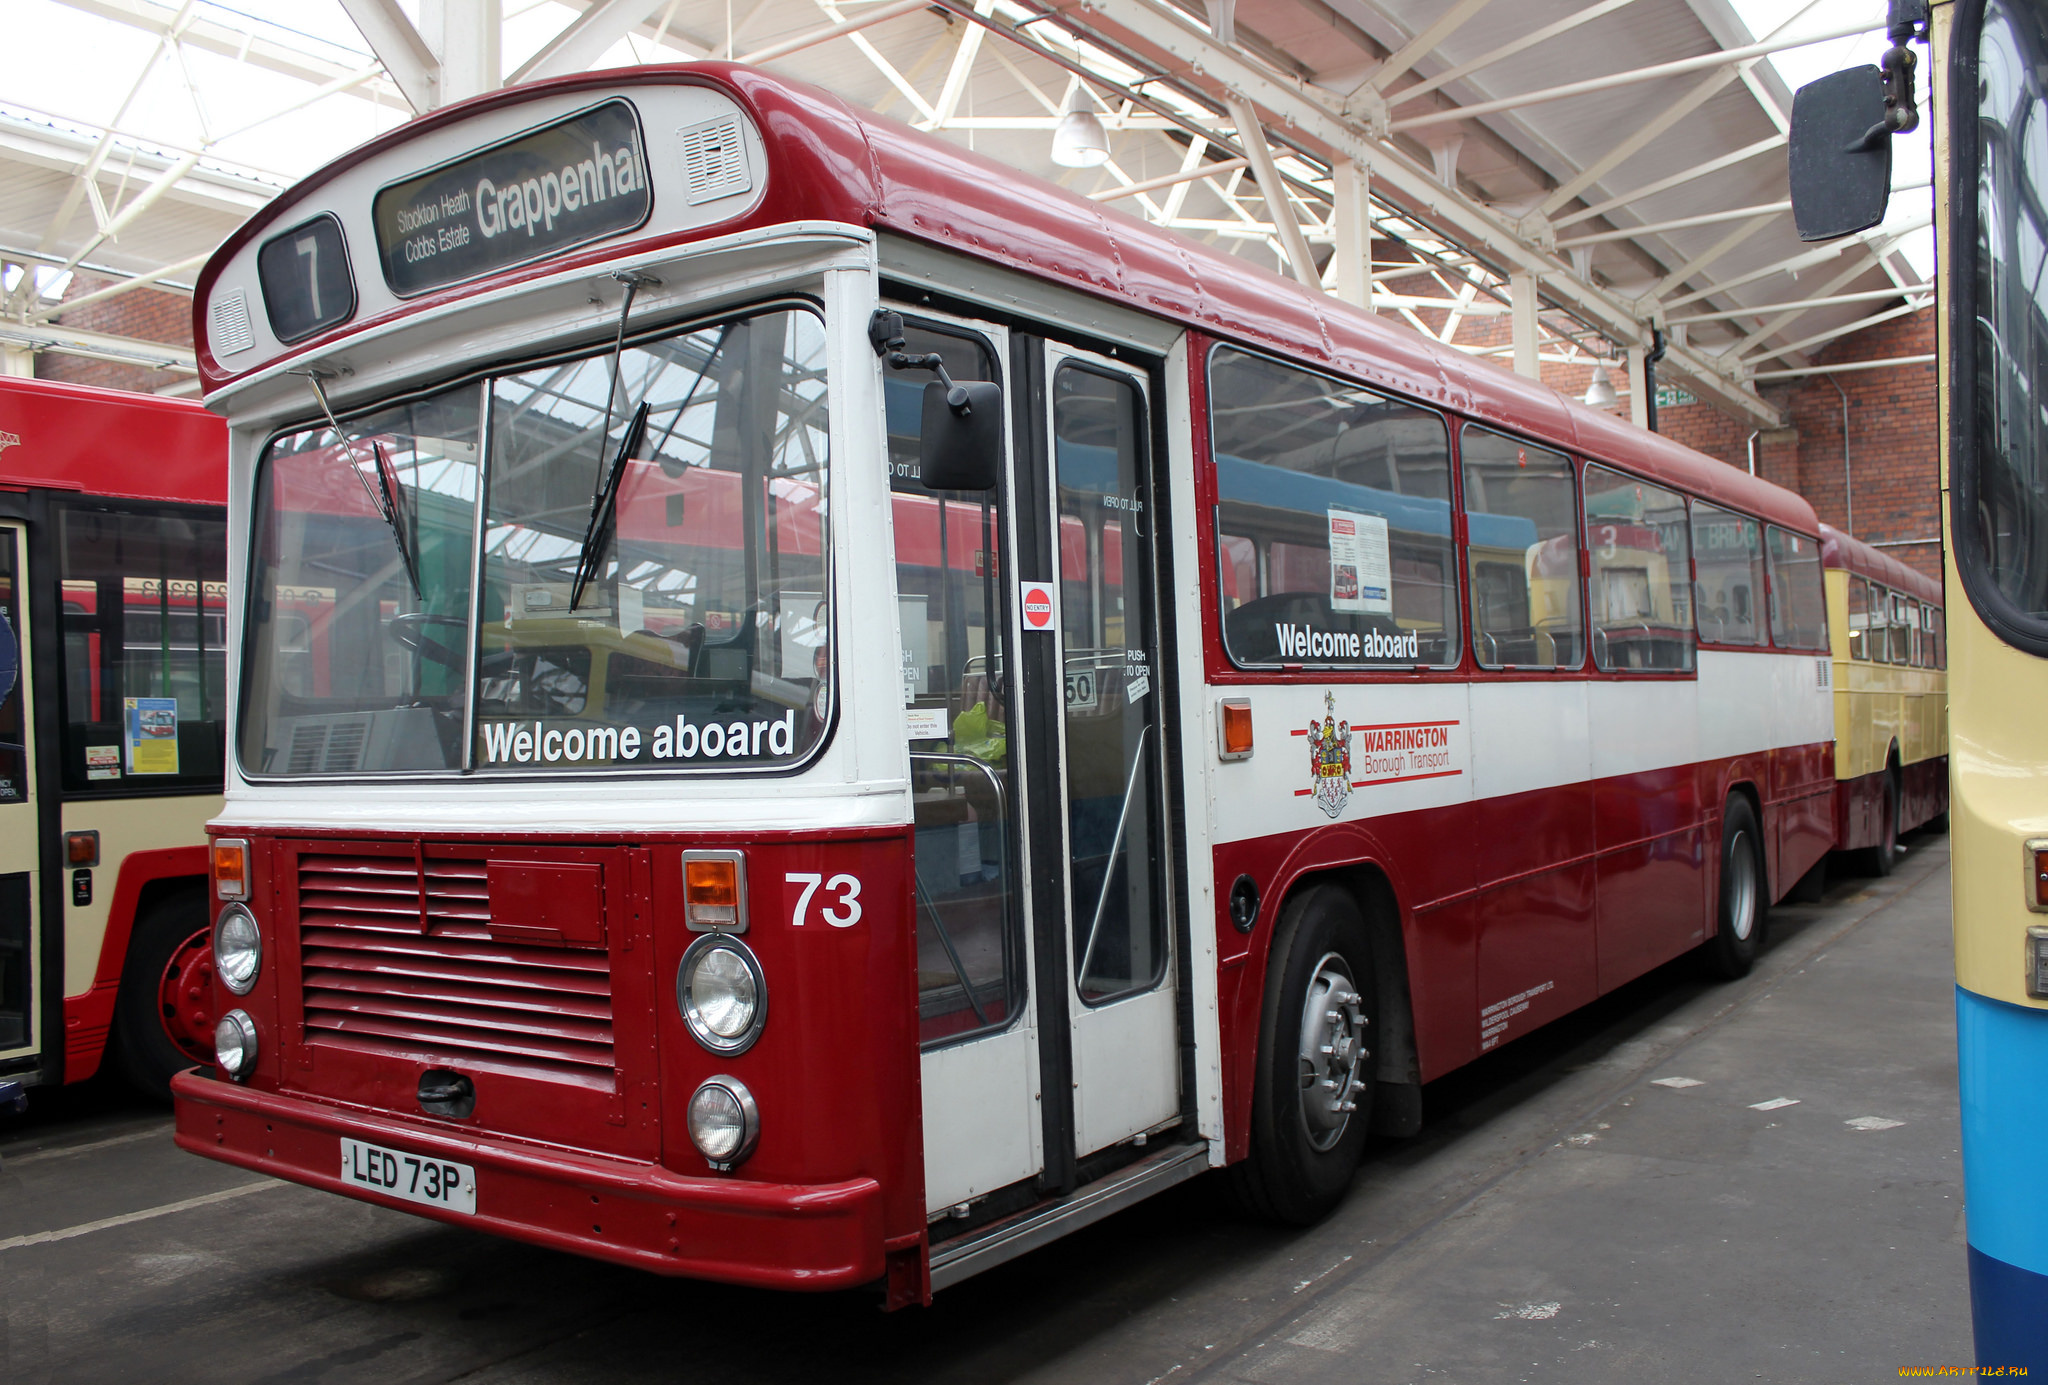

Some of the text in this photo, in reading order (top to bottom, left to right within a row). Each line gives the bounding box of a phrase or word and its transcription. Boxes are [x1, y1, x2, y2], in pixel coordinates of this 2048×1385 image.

[397, 188, 471, 234] Stockton Heath
[405, 223, 470, 264] Cobbs Estate
[295, 235, 323, 320] 7
[1034, 604, 1049, 612] ENTRY
[1127, 650, 1146, 661] PUSH
[1275, 623, 1419, 658] Welcome aboard
[1135, 665, 1151, 676] OPEN
[484, 709, 795, 763] Welcome aboard
[1364, 727, 1448, 753] WARRINGTON
[1365, 749, 1450, 776] Borough Transport
[785, 872, 862, 928] 73
[1481, 1000, 1508, 1018] WARRINGTON
[353, 1144, 460, 1201] LED 73P
